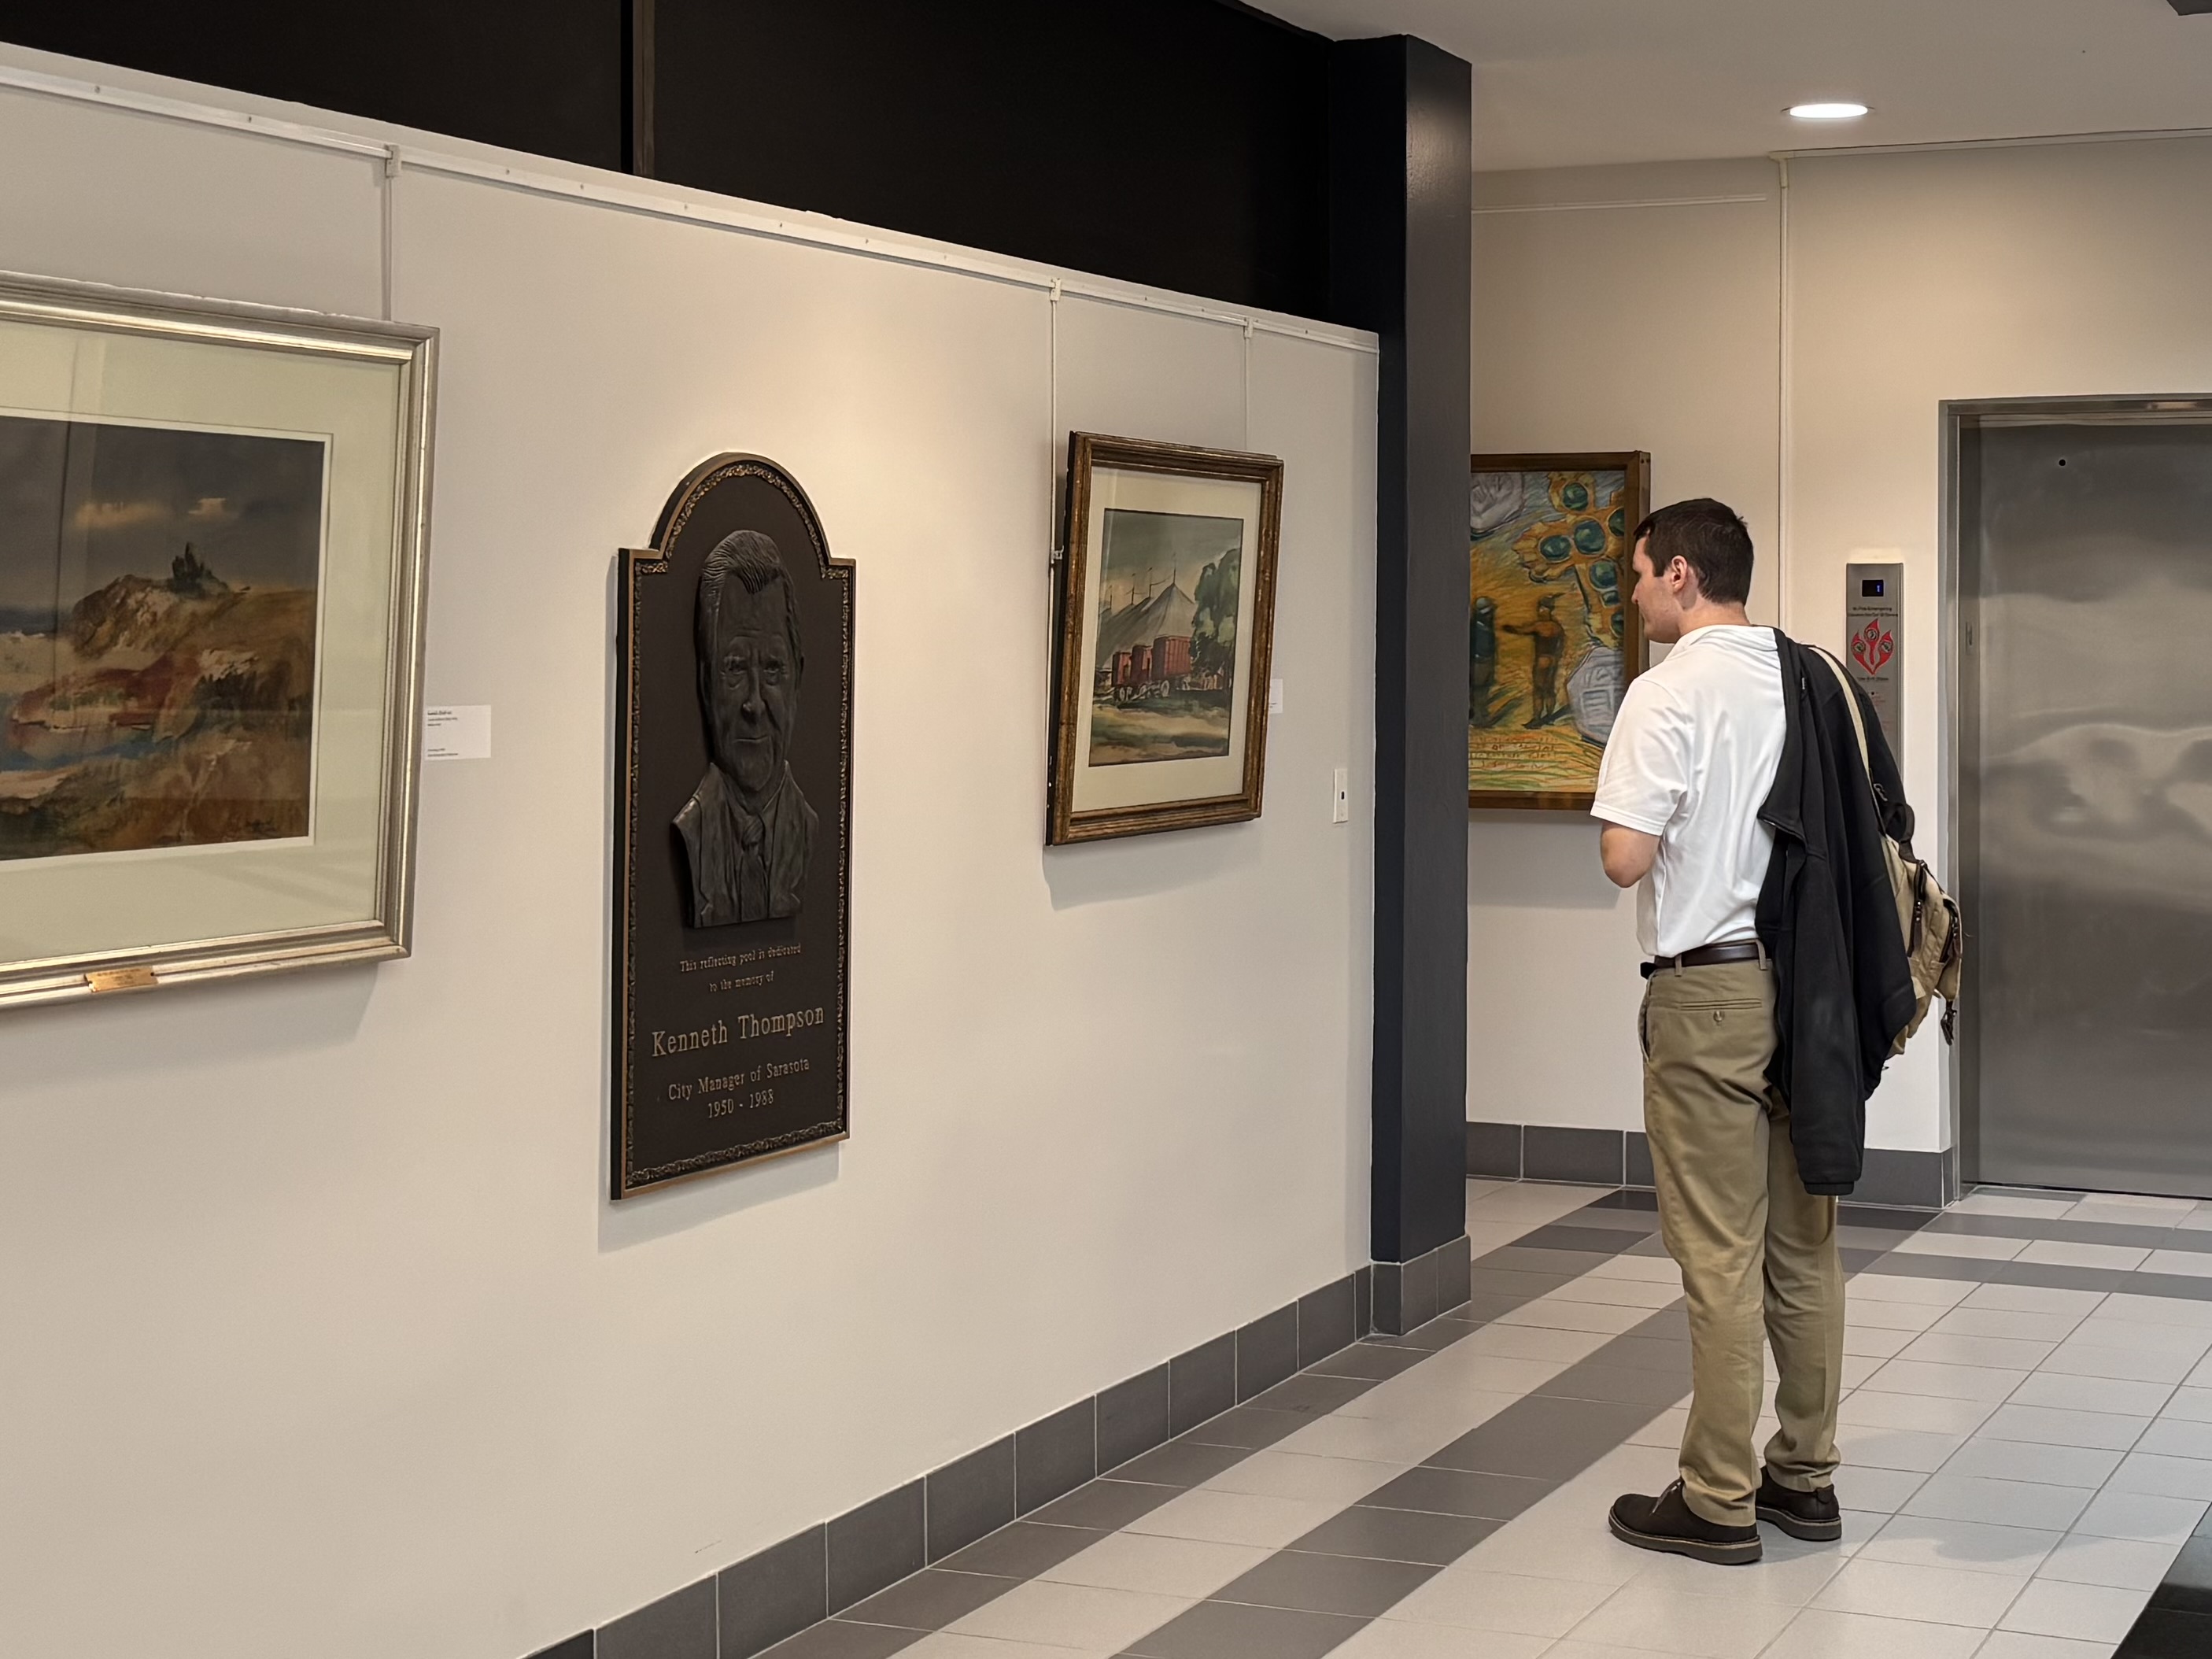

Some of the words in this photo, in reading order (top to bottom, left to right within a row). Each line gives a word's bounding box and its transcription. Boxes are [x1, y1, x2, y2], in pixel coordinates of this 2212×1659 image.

[680, 959, 696, 972] This
[700, 955, 737, 970] reflecting
[740, 950, 755, 965] pool
[759, 948, 765, 959] is
[768, 944, 801, 958] dedicated
[709, 983, 718, 992] to
[721, 979, 732, 989] the
[735, 974, 763, 988] memory
[766, 970, 774, 982] of
[652, 1020, 728, 1057] Kenneth
[737, 1007, 824, 1039] Thompson
[669, 1083, 692, 1100] City
[698, 1073, 744, 1094] Manager
[750, 1066, 761, 1082] of
[766, 1058, 810, 1078] Sarasota
[708, 1099, 734, 1118] 1950
[749, 1088, 774, 1108] 1988
